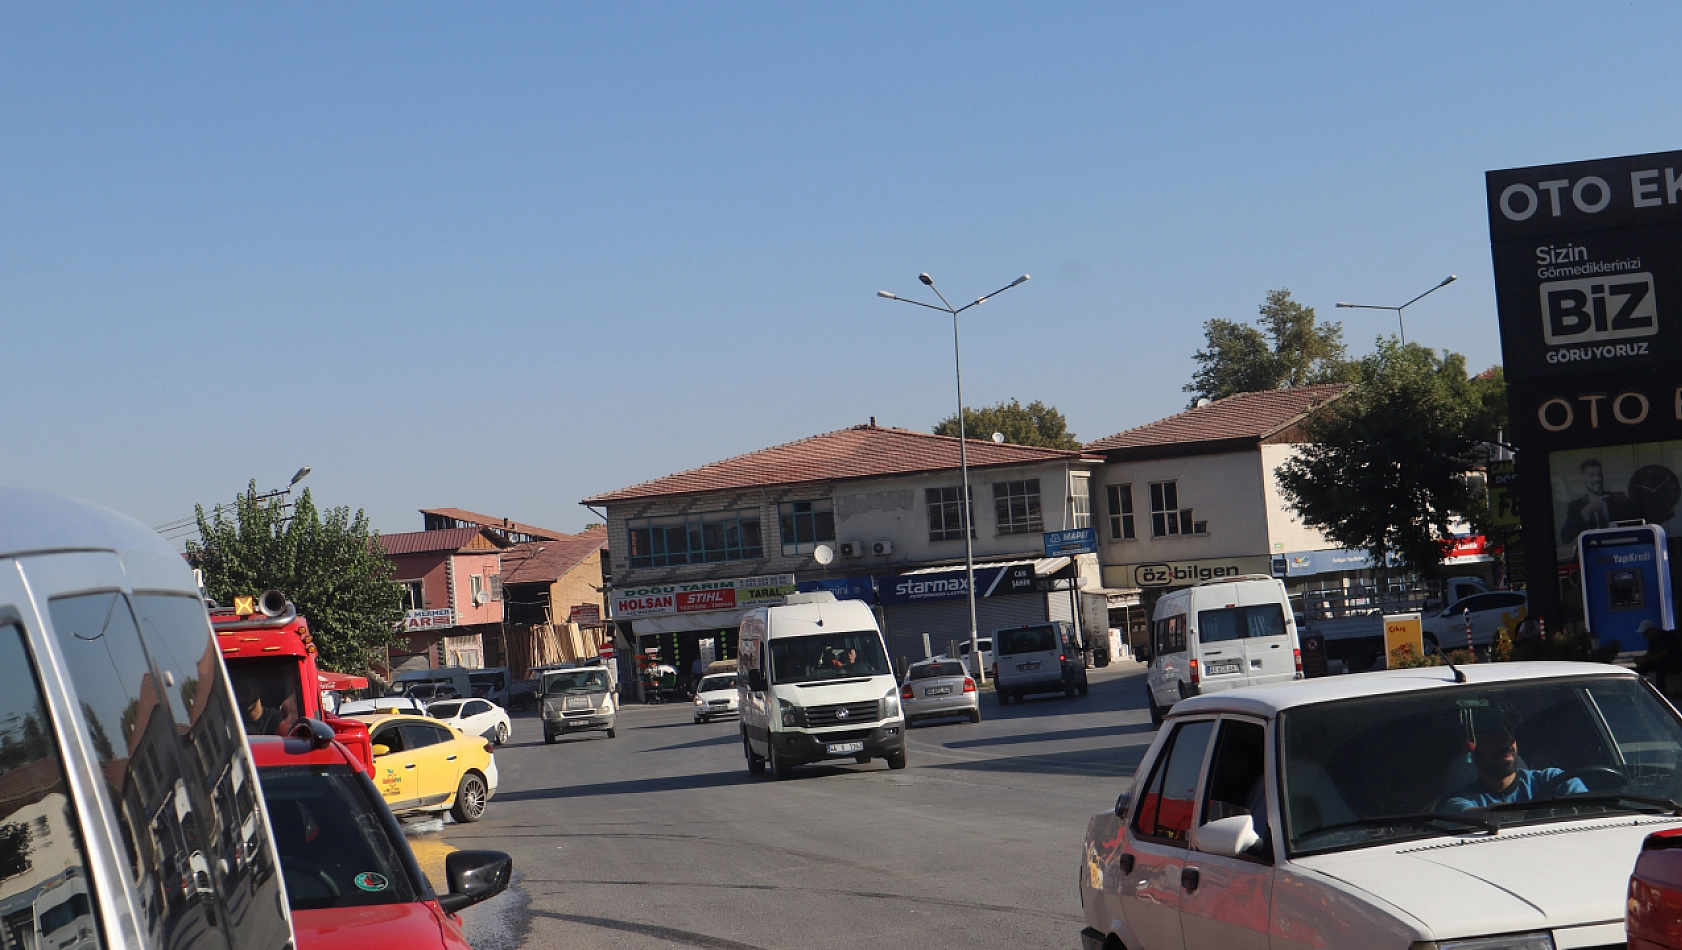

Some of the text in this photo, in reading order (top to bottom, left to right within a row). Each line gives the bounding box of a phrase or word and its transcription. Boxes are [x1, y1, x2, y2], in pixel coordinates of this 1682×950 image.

[1499, 176, 1611, 221] OTO
[1535, 243, 1588, 265] Sizin
[1537, 257, 1641, 278] Görmediklerinizi
[1546, 342, 1649, 364] GÖRÜYORUZ
[1537, 390, 1649, 432] OTO
[1063, 531, 1088, 541] MAPEI
[625, 586, 675, 597] DOĞU
[679, 581, 735, 592] TARIM
[687, 591, 724, 604] STIHL
[748, 587, 782, 599] TARAL
[618, 596, 673, 612] HOLSAN
